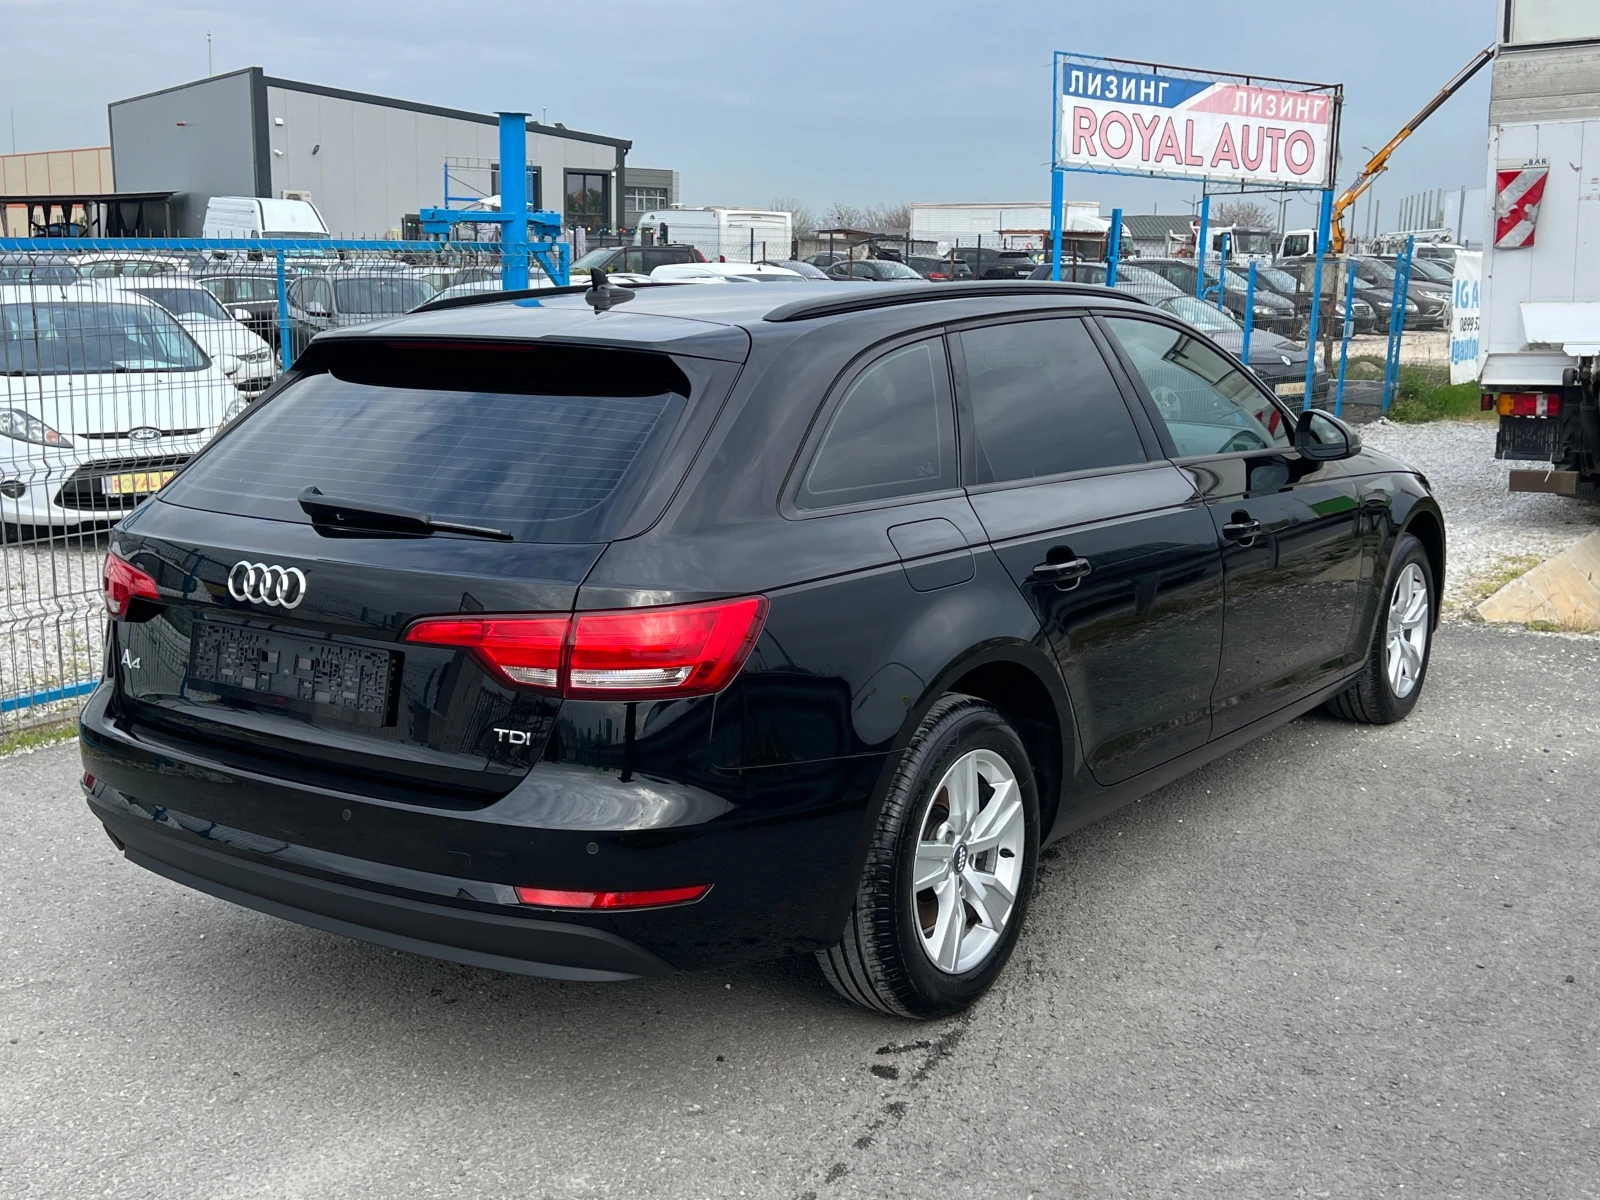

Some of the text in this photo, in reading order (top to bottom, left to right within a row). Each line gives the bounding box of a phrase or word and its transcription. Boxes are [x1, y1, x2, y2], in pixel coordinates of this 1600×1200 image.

[1069, 70, 1170, 104] ЛИЗИНГ
[1232, 90, 1325, 121] ЛИЗИНГ
[1072, 105, 1315, 175] ROYAL AUTO
[1454, 279, 1469, 309] IG
[121, 648, 141, 670] A4
[493, 727, 531, 746] TDI
